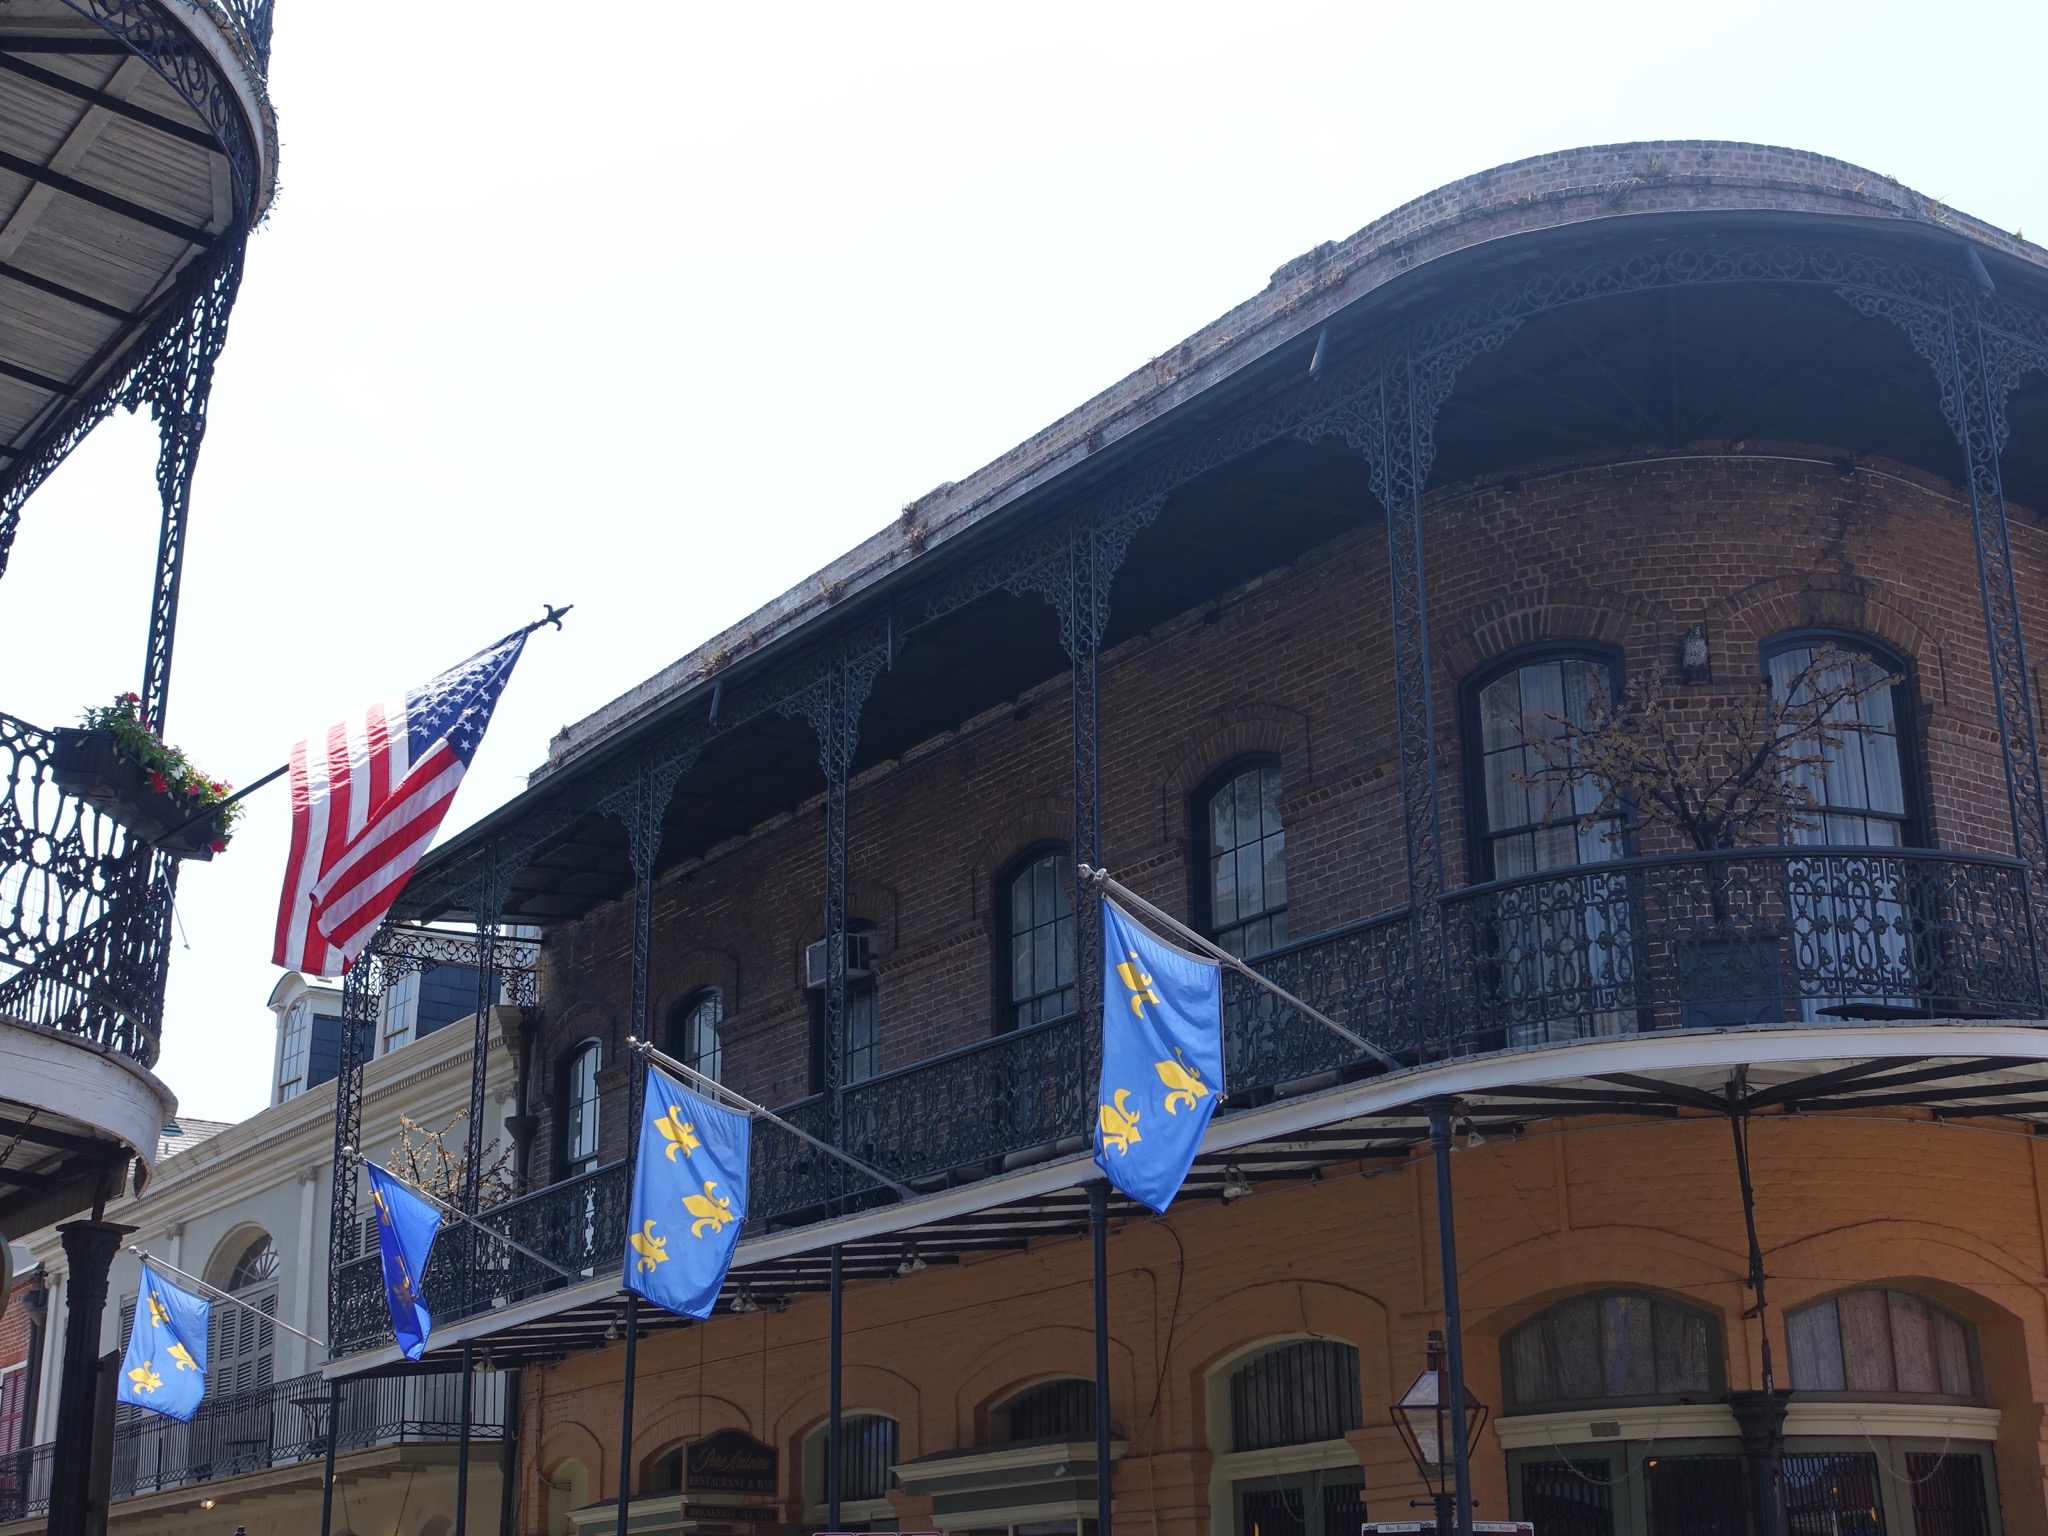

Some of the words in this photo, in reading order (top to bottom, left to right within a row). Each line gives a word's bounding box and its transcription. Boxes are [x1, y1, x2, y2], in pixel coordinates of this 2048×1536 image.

[721, 1449, 772, 1472] Antoine
[688, 1475, 744, 1488] RESTAURANT
[747, 1479, 754, 1488] &
[758, 1479, 775, 1490] BAR
[689, 1507, 736, 1518] BREAKFAST
[738, 1509, 754, 1518] ALL
[757, 1510, 773, 1520] DAY
